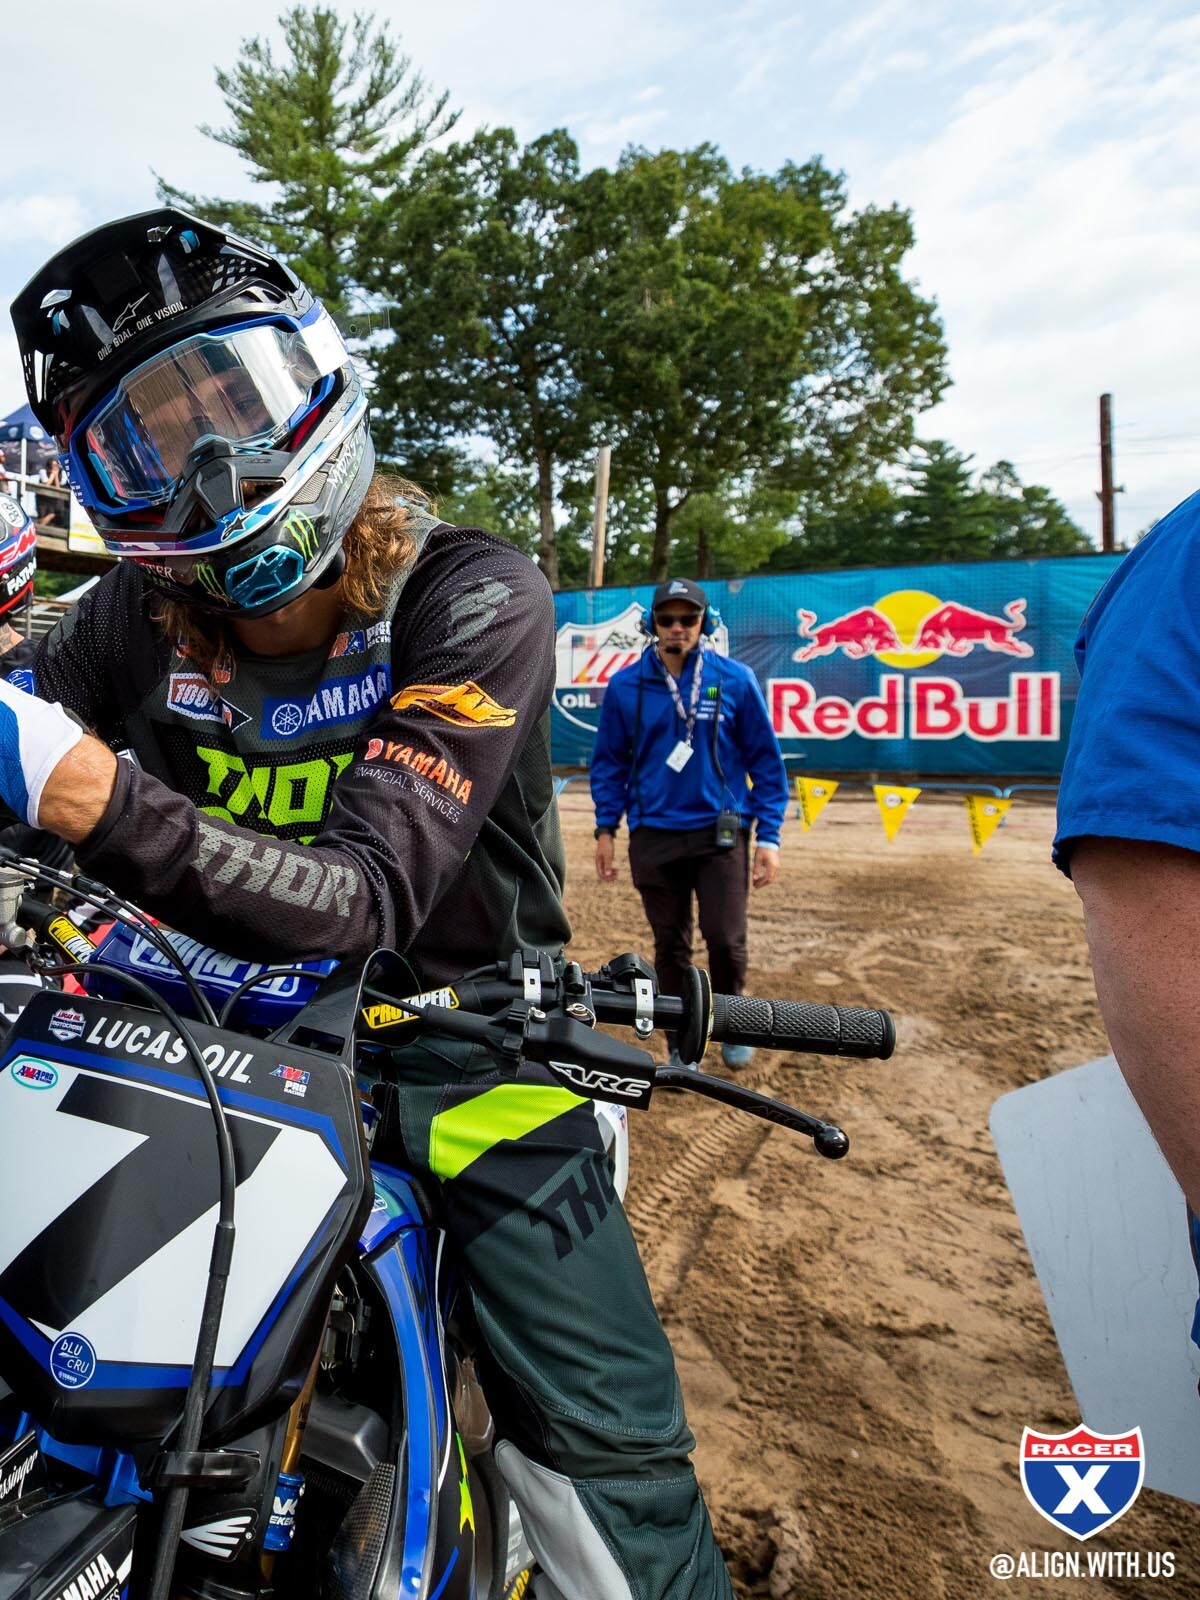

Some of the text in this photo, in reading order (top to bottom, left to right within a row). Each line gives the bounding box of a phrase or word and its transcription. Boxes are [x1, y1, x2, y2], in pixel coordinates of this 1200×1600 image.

[97, 300, 188, 361] ONE GOAL. ONE VISION.
[561, 693, 597, 709] OIL
[771, 674, 1056, 738] Red Bull
[196, 745, 354, 827] THO
[384, 740, 473, 806] YAMAHA
[410, 780, 461, 825] SERVICES
[188, 820, 359, 918] THOR
[85, 1016, 188, 1064] LUCAS
[16, 1065, 54, 1081] AMA PRO
[269, 1063, 311, 1084] AMA
[283, 1079, 308, 1094] PRO
[548, 1060, 651, 1098] ARC
